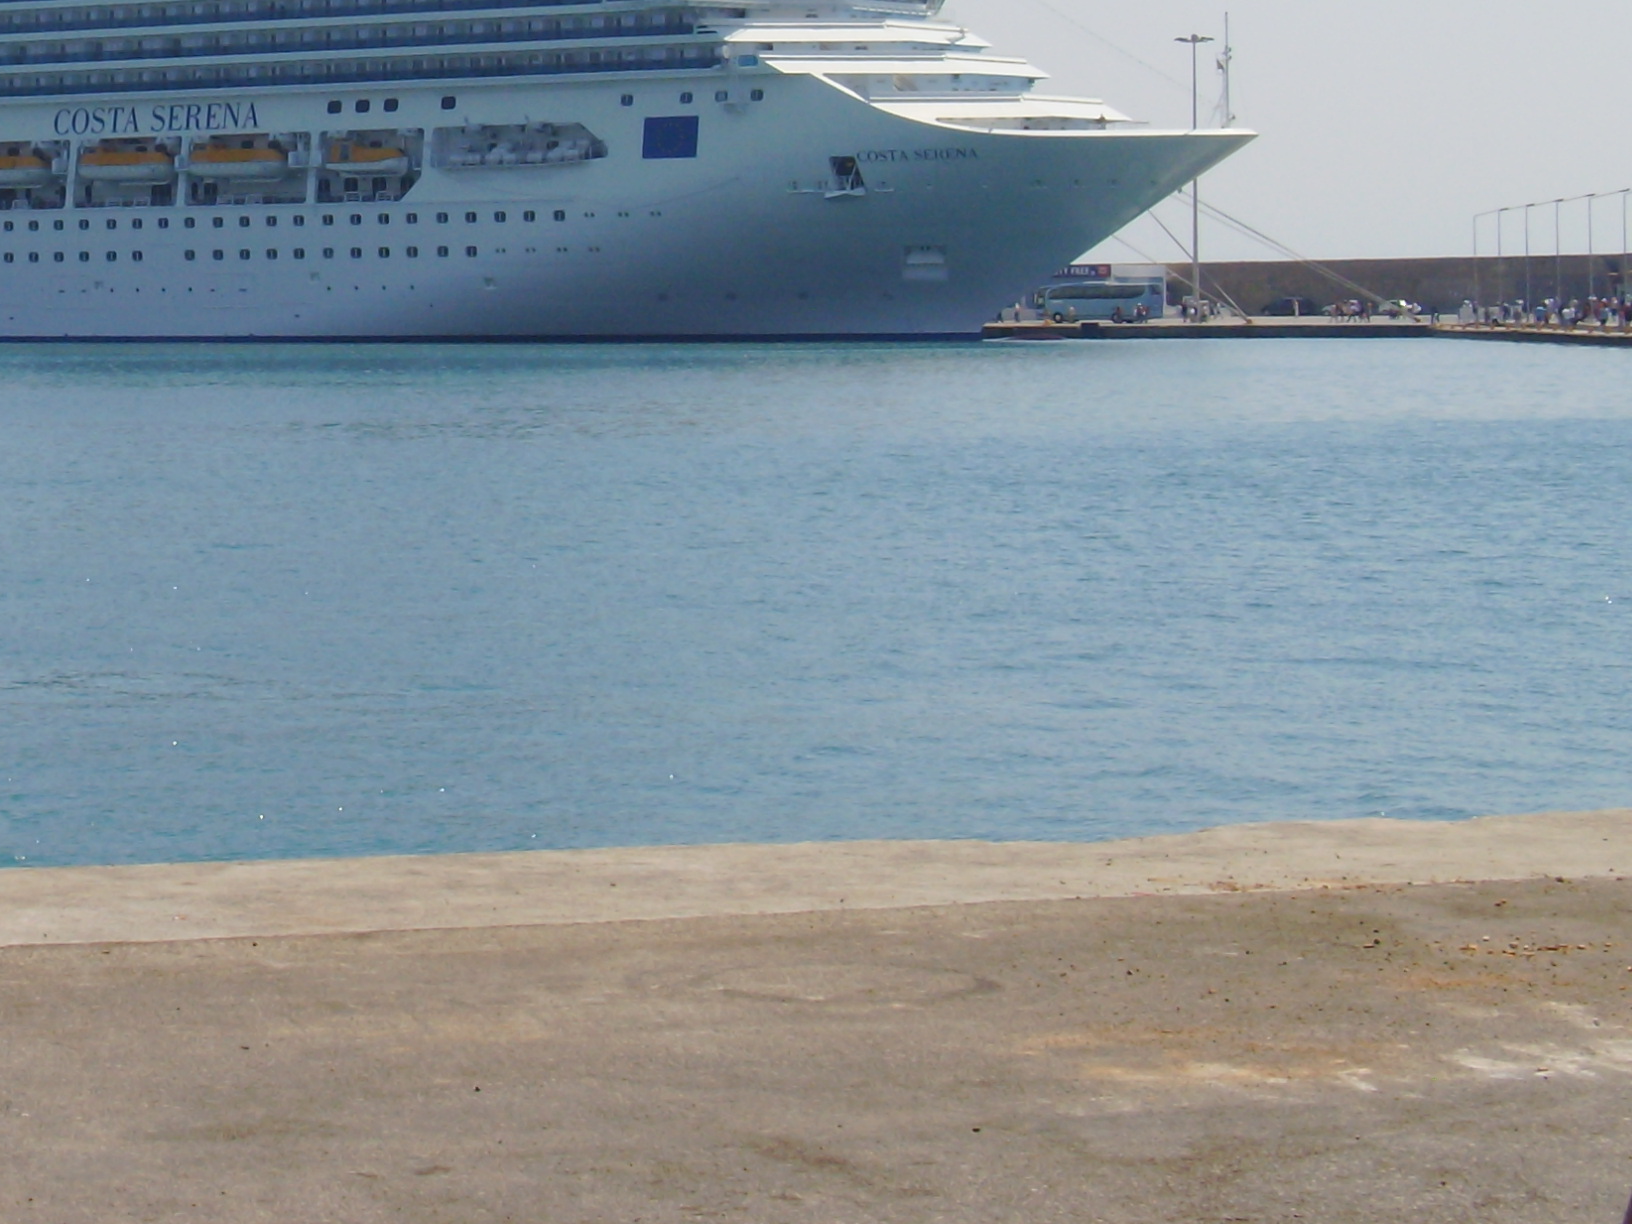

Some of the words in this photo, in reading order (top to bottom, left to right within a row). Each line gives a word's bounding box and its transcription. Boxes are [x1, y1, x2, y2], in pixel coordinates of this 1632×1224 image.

[54, 107, 139, 135] COSTA
[151, 102, 259, 132] SERENA
[856, 149, 908, 163] COSTA
[914, 147, 978, 161] SERENA
